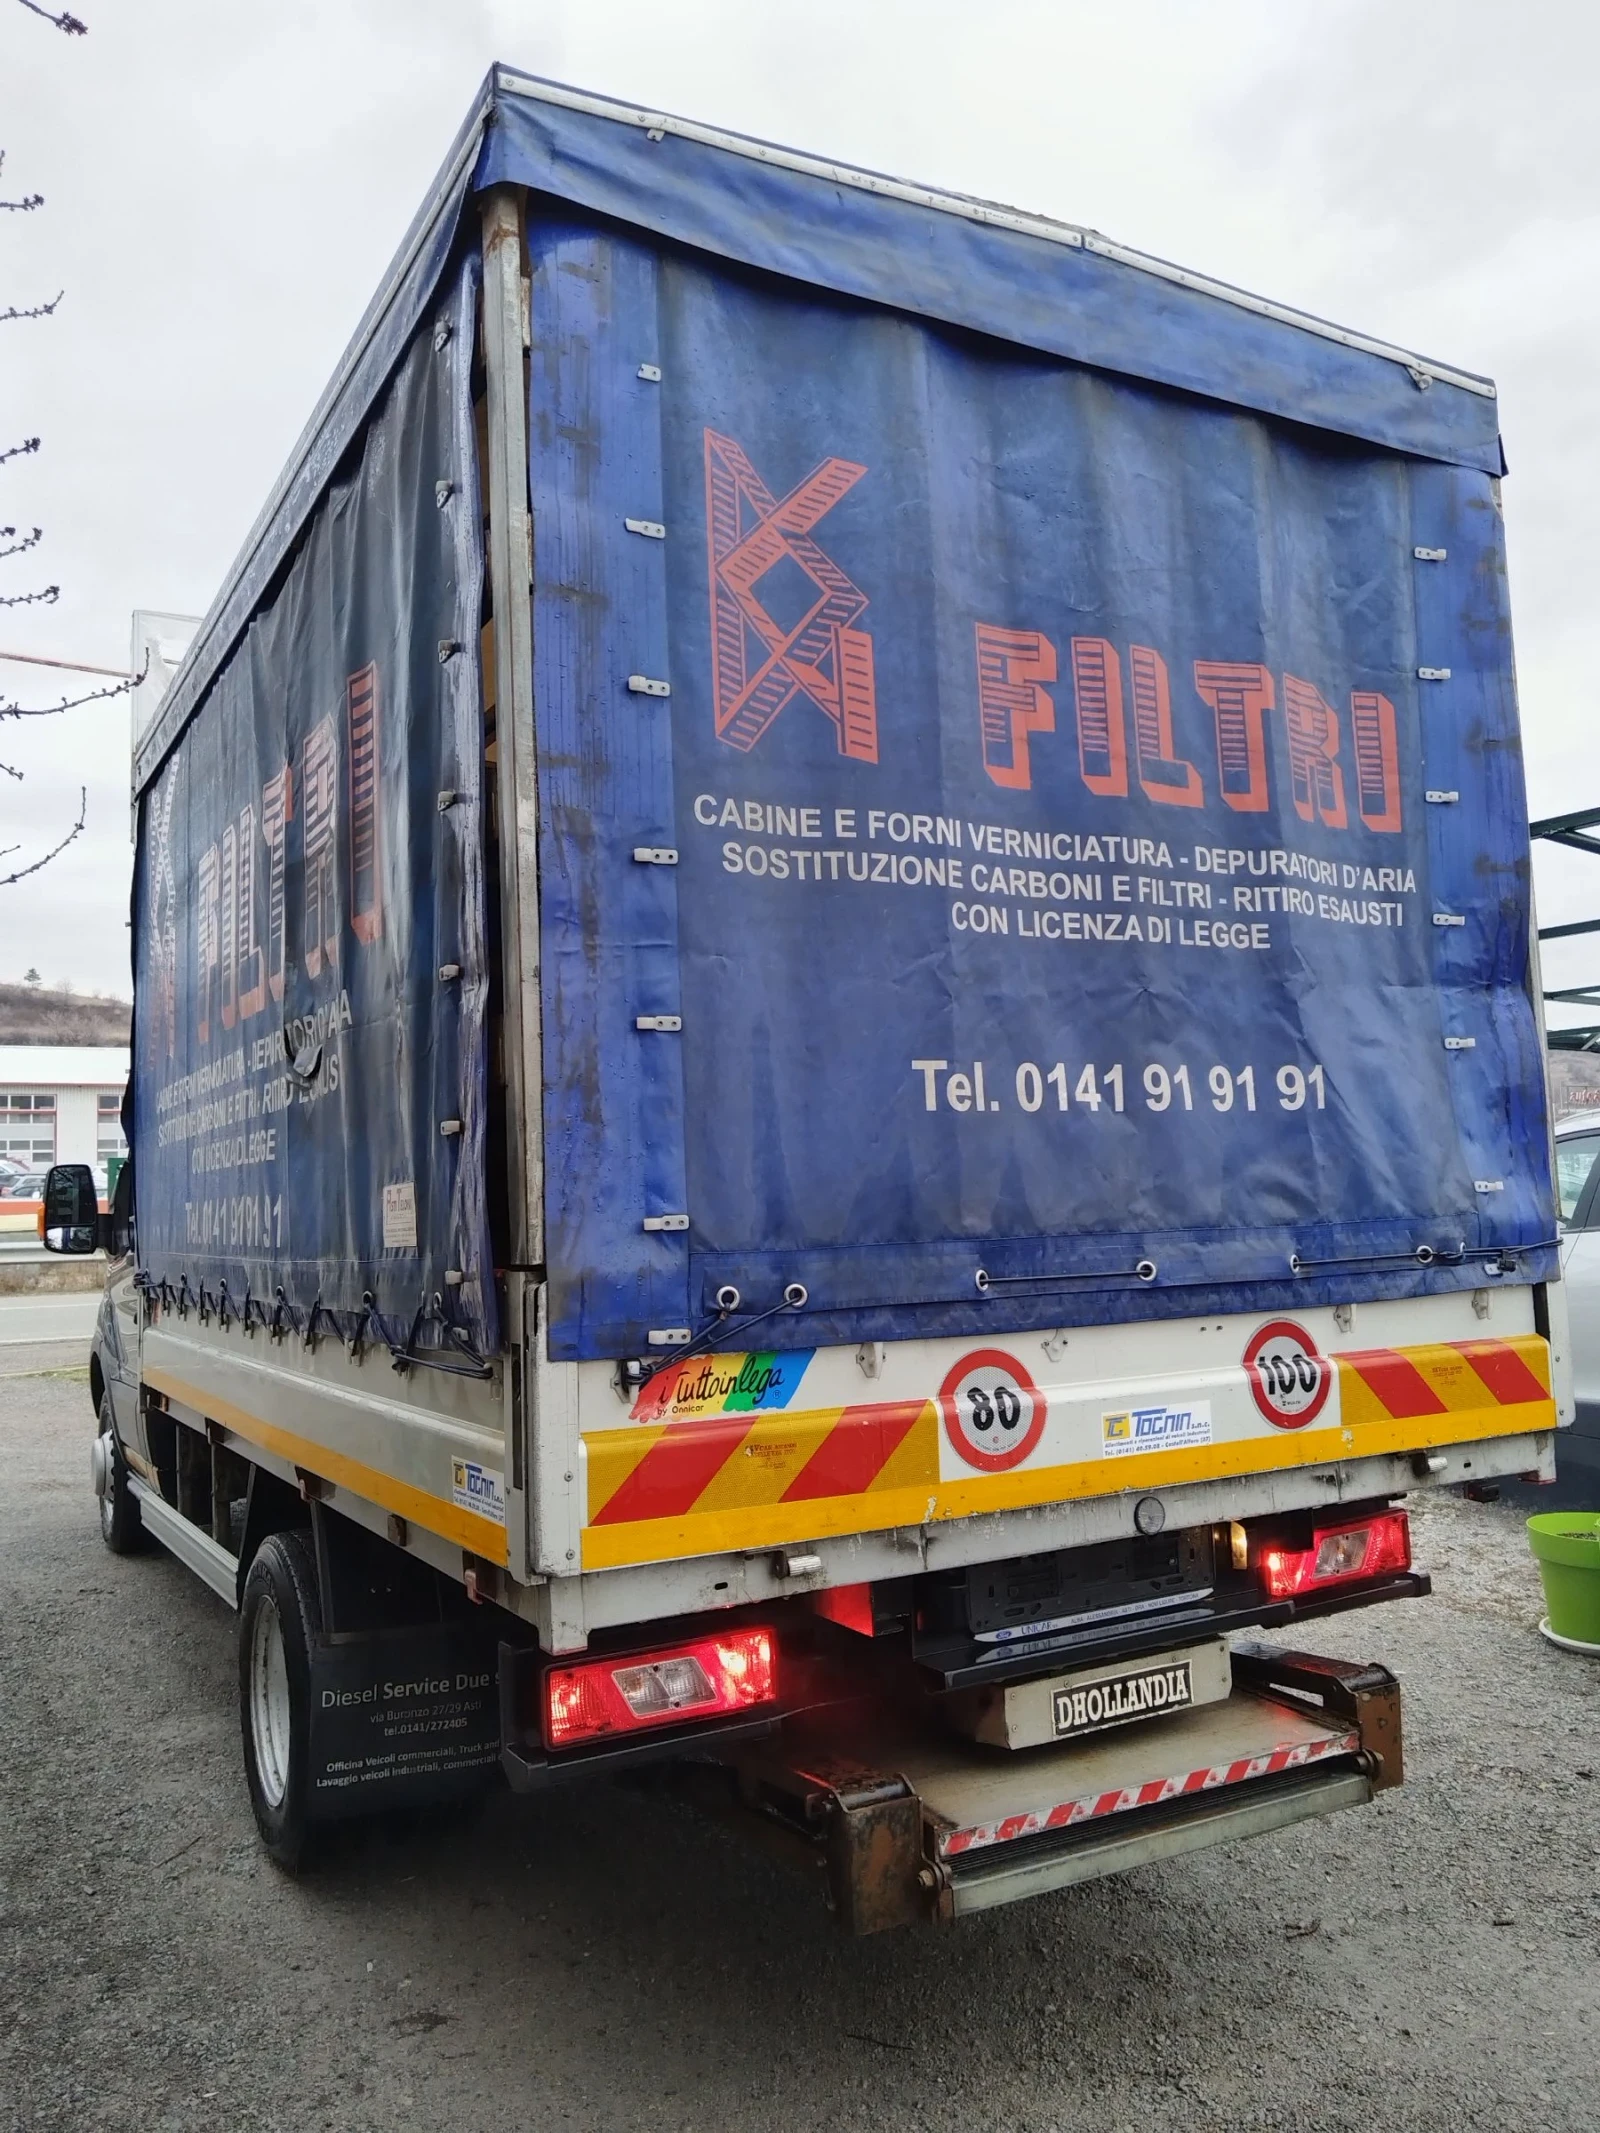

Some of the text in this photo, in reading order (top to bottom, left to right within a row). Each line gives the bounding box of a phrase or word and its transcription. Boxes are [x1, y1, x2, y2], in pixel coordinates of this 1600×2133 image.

[975, 622, 1401, 833] FILTRI
[694, 794, 822, 837] CABINE
[835, 809, 857, 838] E
[868, 810, 961, 848] FORNI
[967, 822, 1173, 868] VERNICIATURA
[1195, 846, 1338, 887] DEPURATORI
[1343, 864, 1416, 894] D'ARIA
[722, 841, 964, 890] SOSTITUZIONE
[970, 863, 1102, 902] CARBONI
[1112, 875, 1131, 902] E
[1138, 877, 1212, 909] FILTRI
[1234, 886, 1315, 916] RITIRO
[1318, 894, 1403, 927] ESAUSTI
[951, 901, 1271, 949] CON LICENZA DI LEGGE
[911, 1060, 1326, 1113] Tel. 0141 91 91 91
[1258, 1354, 1317, 1395] 100
[657, 1404, 704, 1416] by Onnicar
[967, 1386, 1020, 1431] 80
[322, 1684, 378, 1708] Diesel
[383, 1677, 450, 1699] Service
[456, 1673, 490, 1690] Due
[370, 1709, 384, 1723] via
[432, 1702, 462, 1715] 27/29
[463, 1700, 482, 1712] Asti
[1057, 1669, 1188, 1730] DHOLLANDIA
[316, 1774, 358, 1789] Lavaggio
[360, 1765, 390, 1781] veicoli
[443, 1754, 496, 1770] commerciali
[326, 1760, 363, 1774] Officina
[365, 1753, 396, 1767] Veicoli
[397, 1746, 457, 1763] commerciali,
[459, 1742, 482, 1754] Truck
